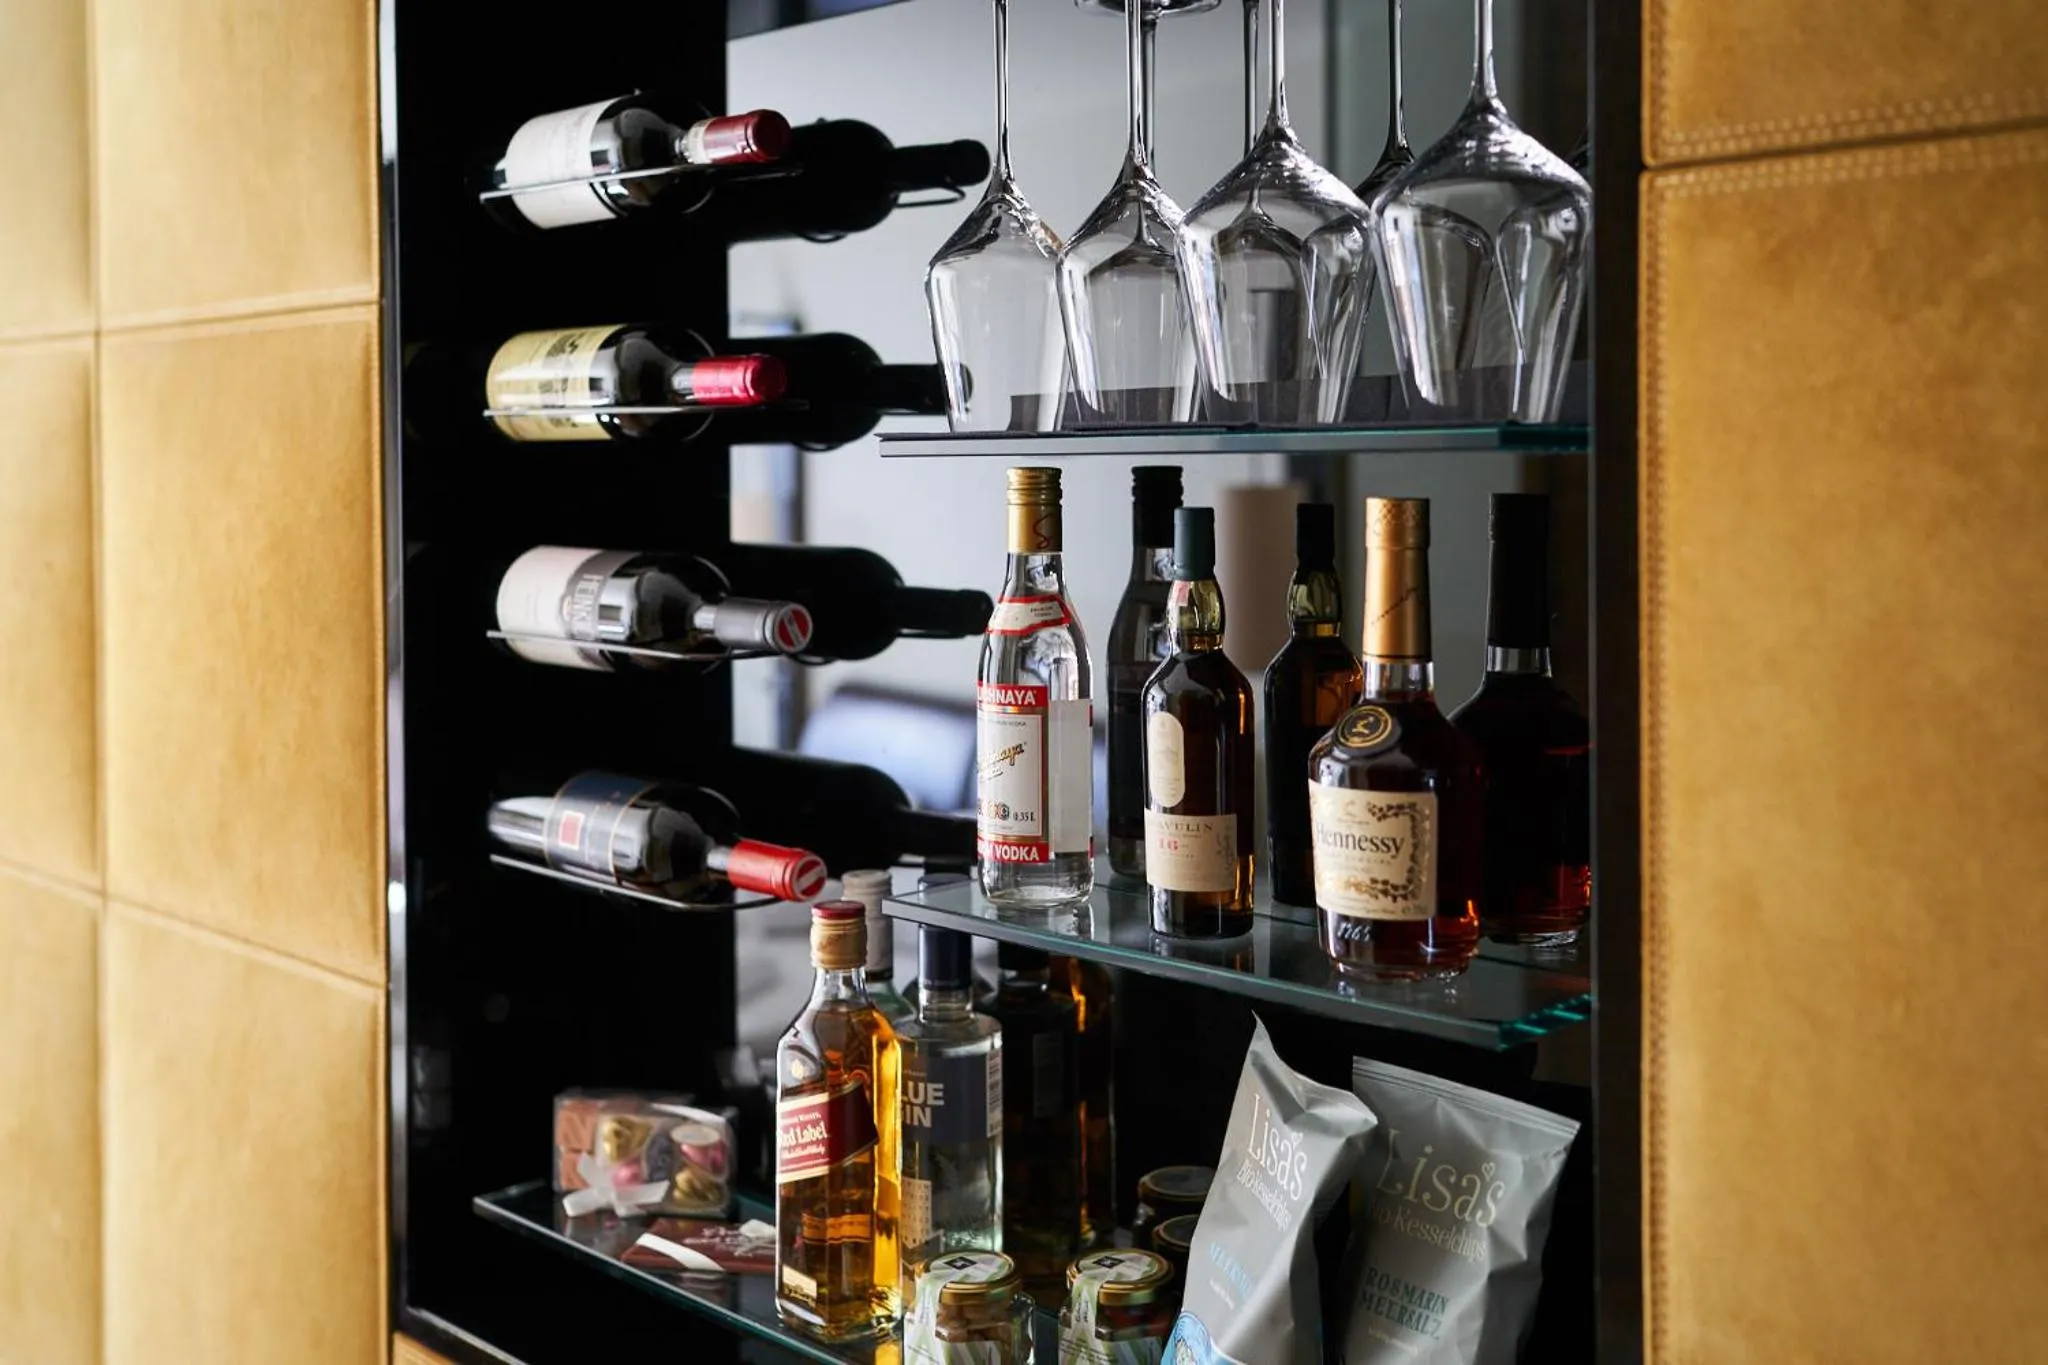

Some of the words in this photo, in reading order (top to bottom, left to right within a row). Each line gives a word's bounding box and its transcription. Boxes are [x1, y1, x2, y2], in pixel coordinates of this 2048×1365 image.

[994, 844, 1040, 861] VODKA
[1316, 821, 1405, 860] Hennessy
[795, 1120, 829, 1145] Label
[1365, 1265, 1450, 1315] ROSMARIN
[1360, 1289, 1444, 1340] MEERSALZ
